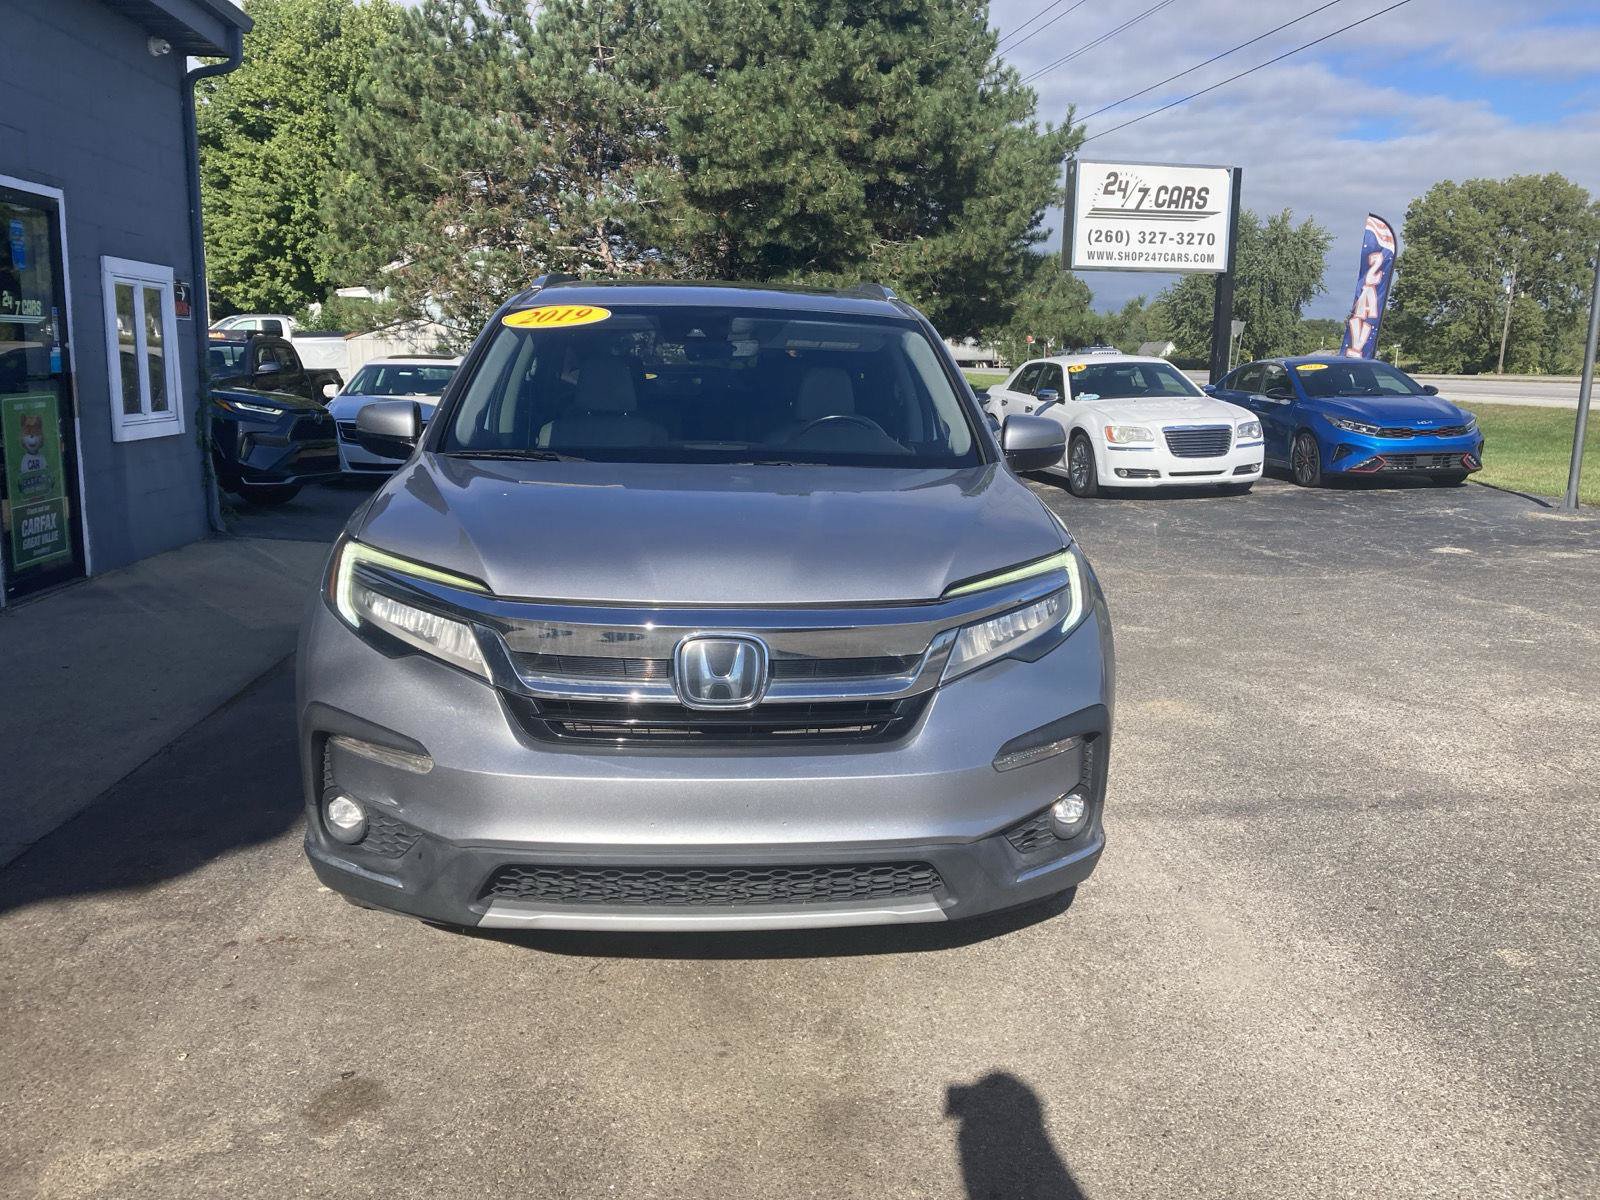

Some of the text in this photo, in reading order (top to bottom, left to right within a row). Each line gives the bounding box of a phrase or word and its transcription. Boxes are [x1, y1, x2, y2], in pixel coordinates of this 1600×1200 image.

[1102, 171, 1210, 210] 24/7 CARS
[1087, 229, 1216, 246] (260) 327-3270
[1087, 250, 1215, 263] WWW.SHOP247CARS.COM
[22, 299, 41, 316] CARS
[518, 308, 593, 325] 2019
[28, 459, 41, 470] CAR
[21, 512, 57, 537] CARFAX
